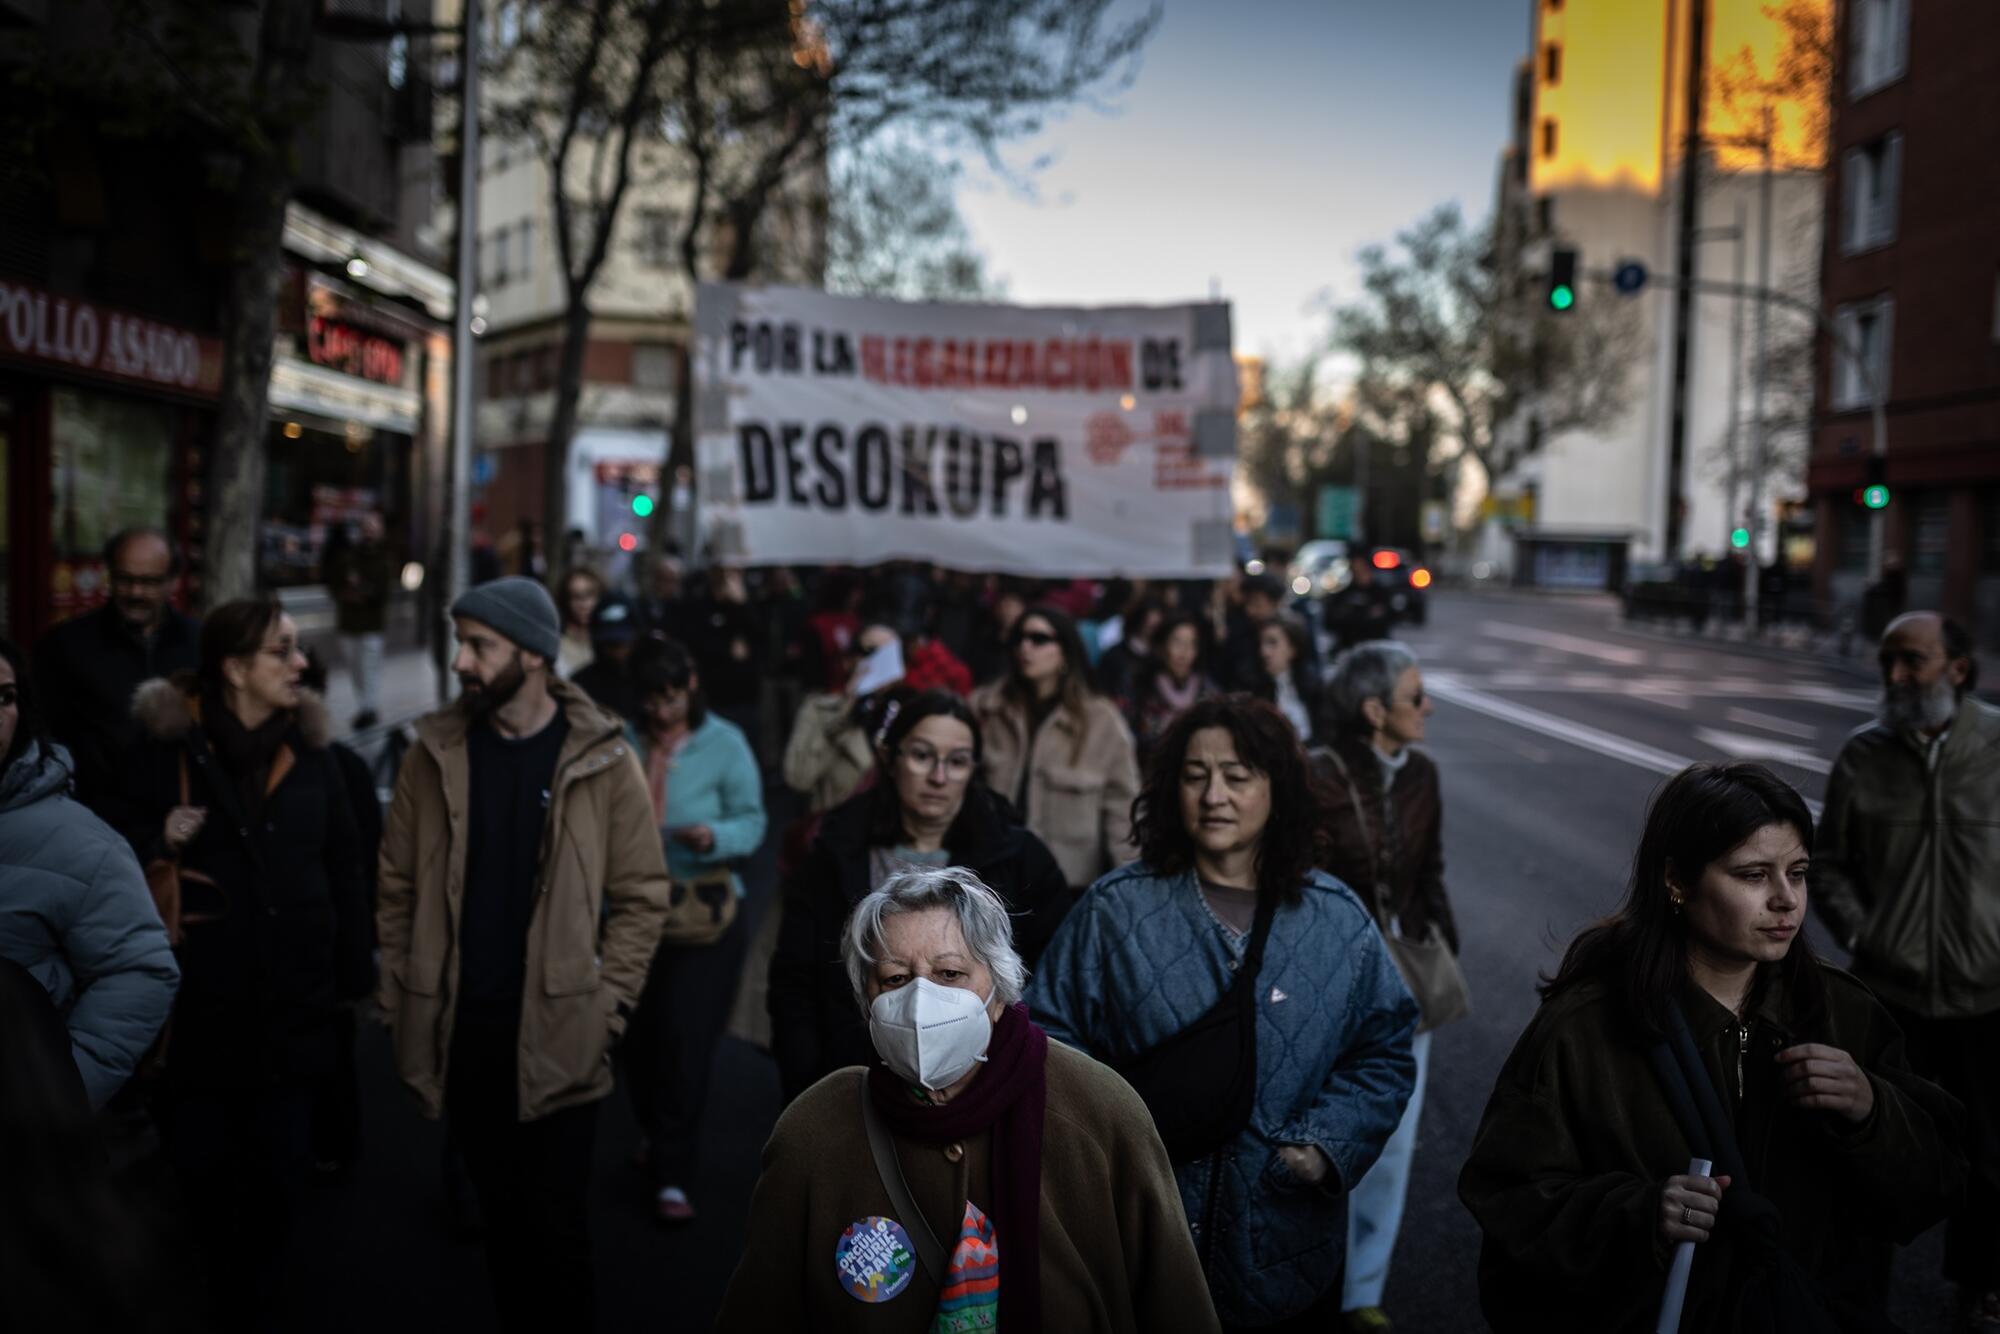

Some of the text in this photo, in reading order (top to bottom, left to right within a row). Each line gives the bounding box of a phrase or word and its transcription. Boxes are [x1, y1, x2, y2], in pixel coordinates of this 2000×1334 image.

[102, 313, 200, 385] ASADO
[731, 321, 802, 375] POR
[814, 330, 855, 375] LA
[1142, 336, 1183, 392] DE
[740, 422, 1070, 519] DESOKUPA
[839, 1221, 887, 1269] ORGULLO
[846, 1264, 858, 1277] Y
